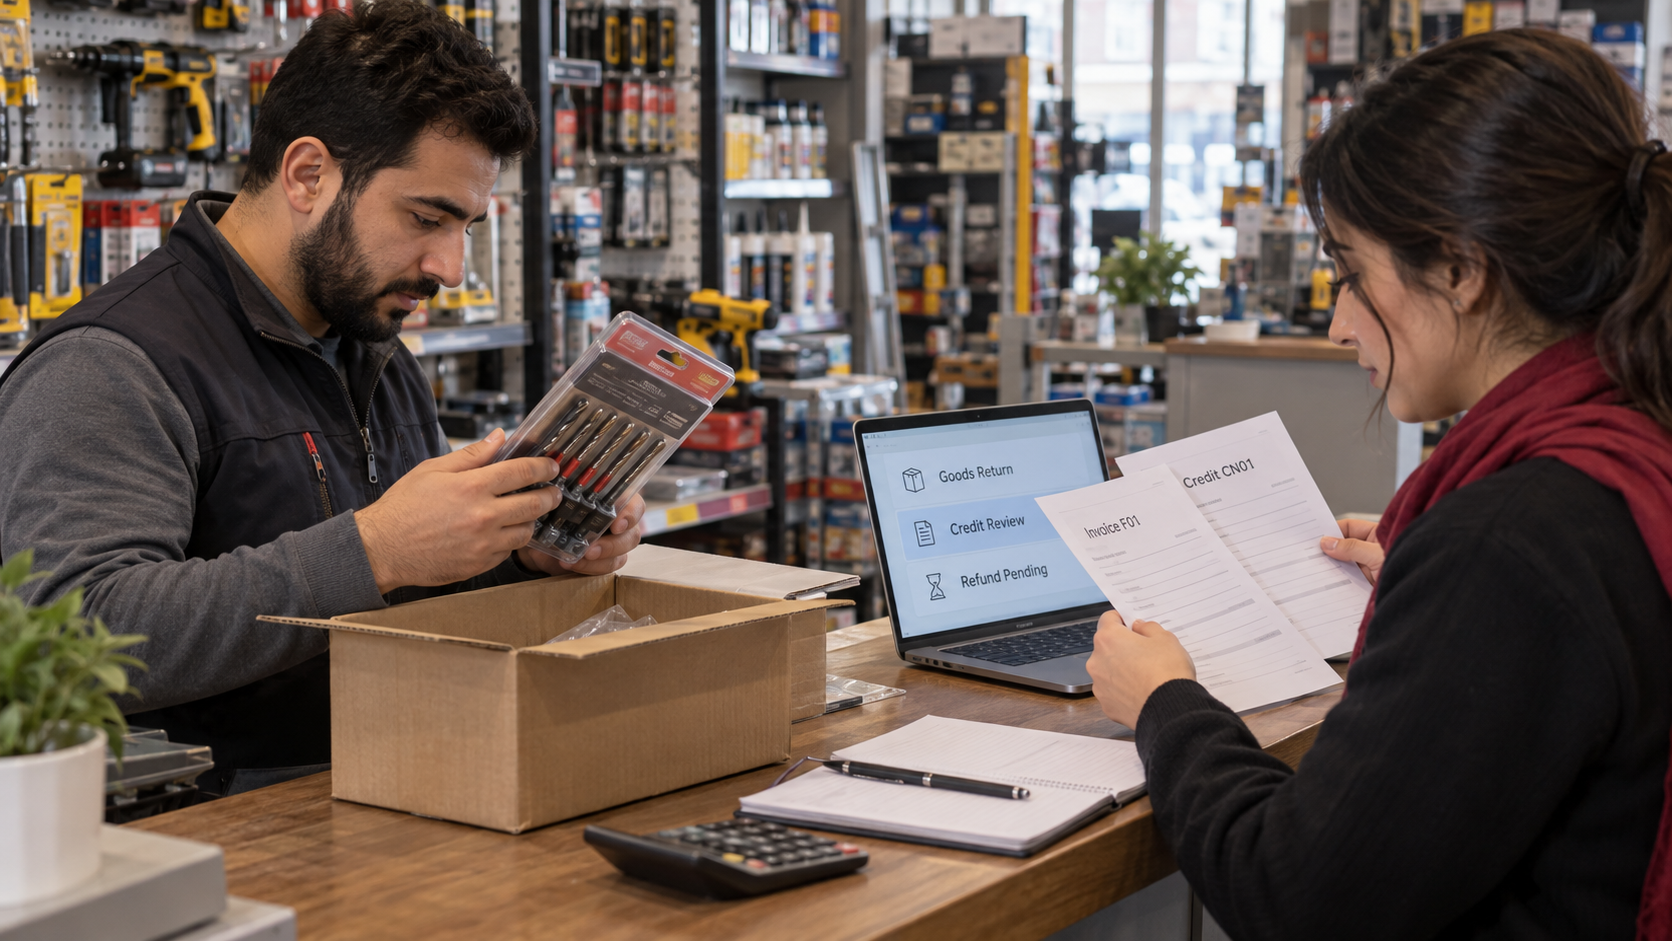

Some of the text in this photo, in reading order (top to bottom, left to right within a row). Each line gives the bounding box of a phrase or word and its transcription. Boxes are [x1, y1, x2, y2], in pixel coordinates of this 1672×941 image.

[939, 465, 1013, 483] Goods Return
[1183, 458, 1255, 489] Credit CN01
[950, 516, 1025, 535] Credit Review
[1084, 515, 1140, 539] Invoice F01
[961, 564, 1048, 588] Refund Pending
